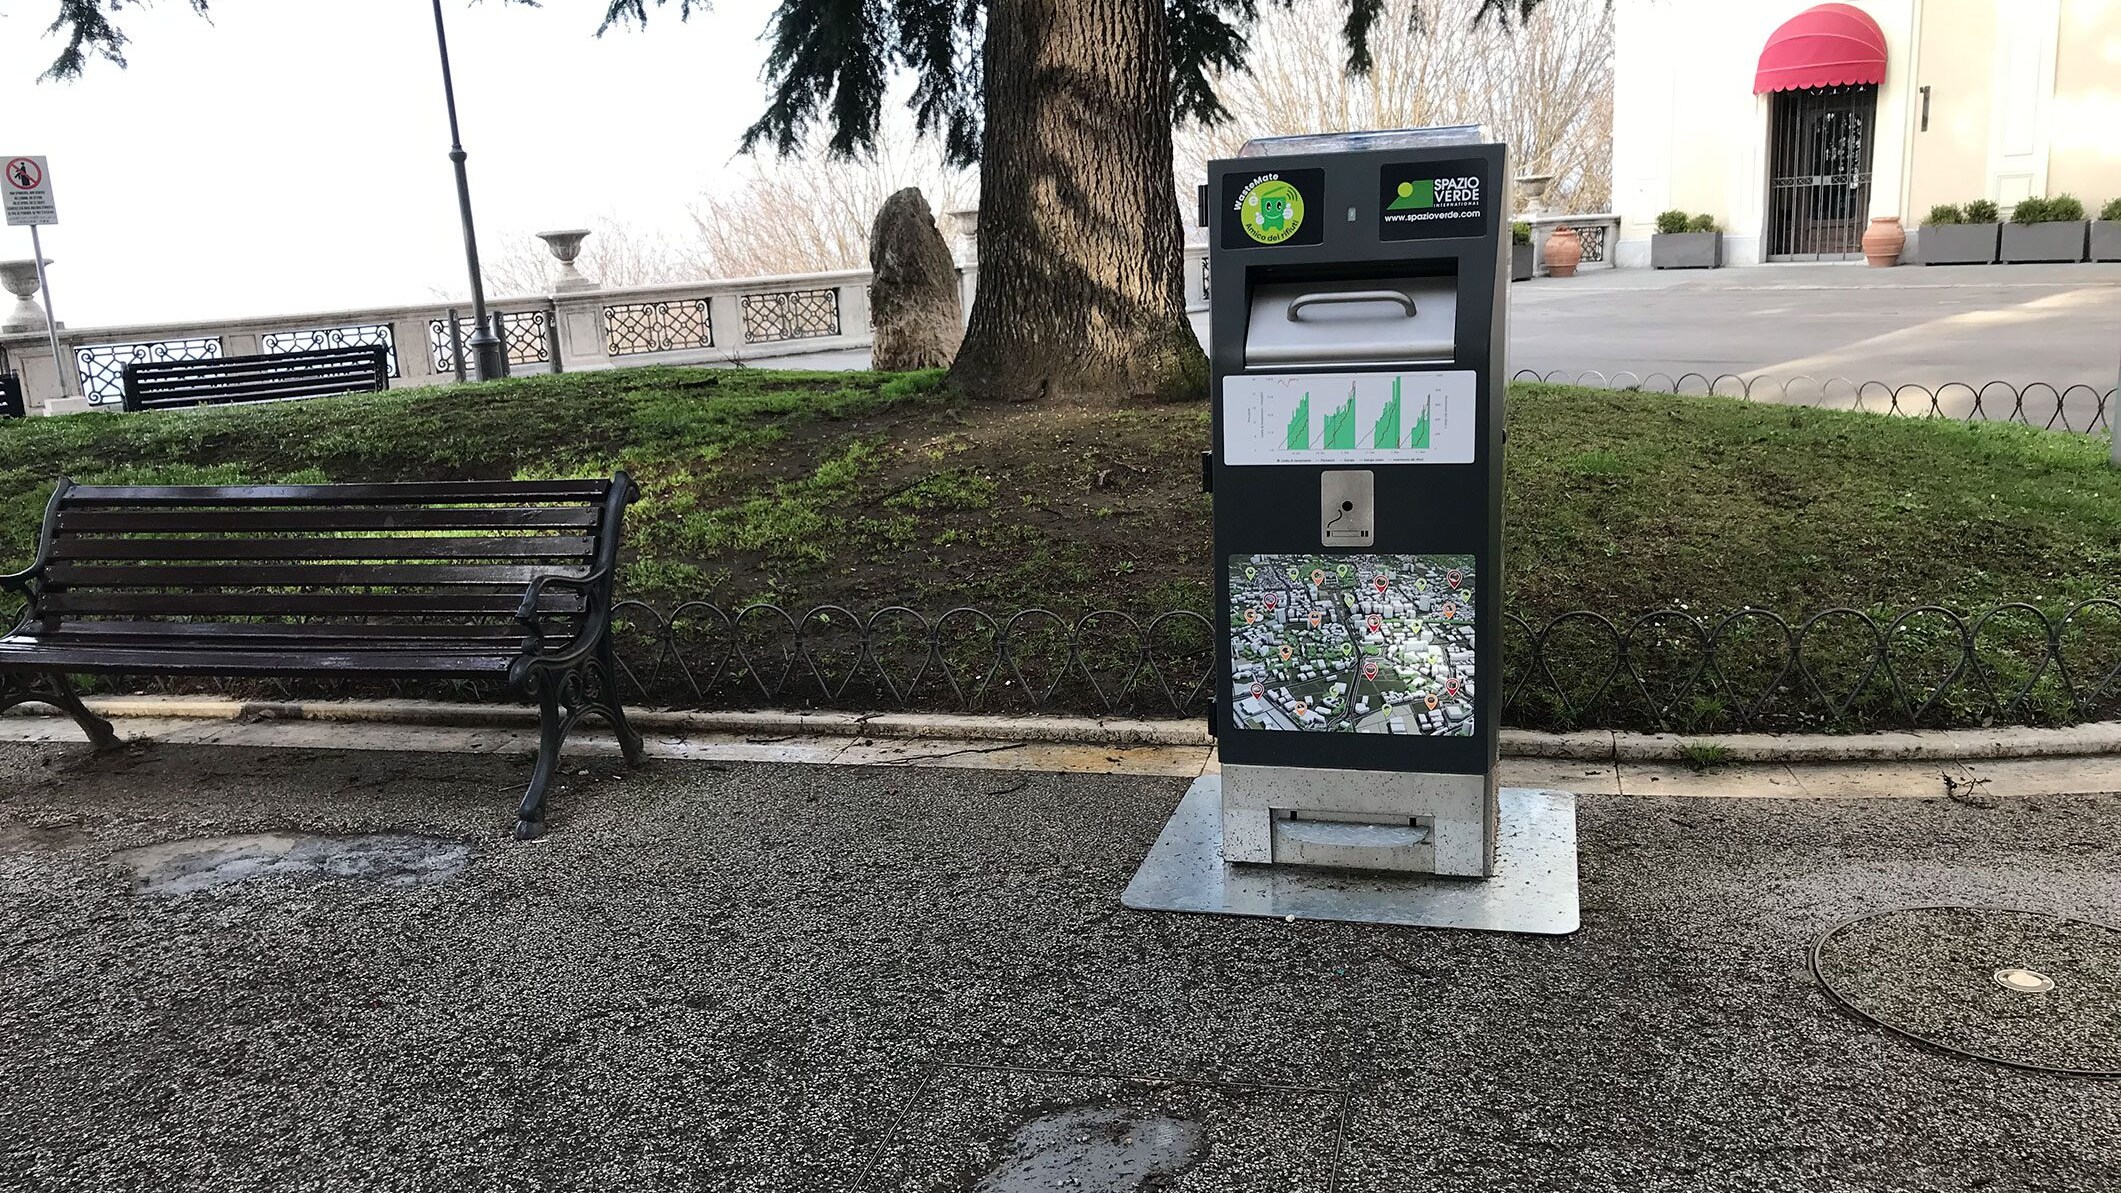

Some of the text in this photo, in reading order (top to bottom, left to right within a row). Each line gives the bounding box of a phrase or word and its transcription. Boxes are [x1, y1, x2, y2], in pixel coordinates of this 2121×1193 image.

[1434, 176, 1480, 191] SPAZIO
[1233, 172, 1279, 211] WasteMate
[1434, 188, 1480, 203] VERDE
[1384, 210, 1481, 222] www.spazioverde.com
[1246, 220, 1299, 242] Amico dei rifiuti
